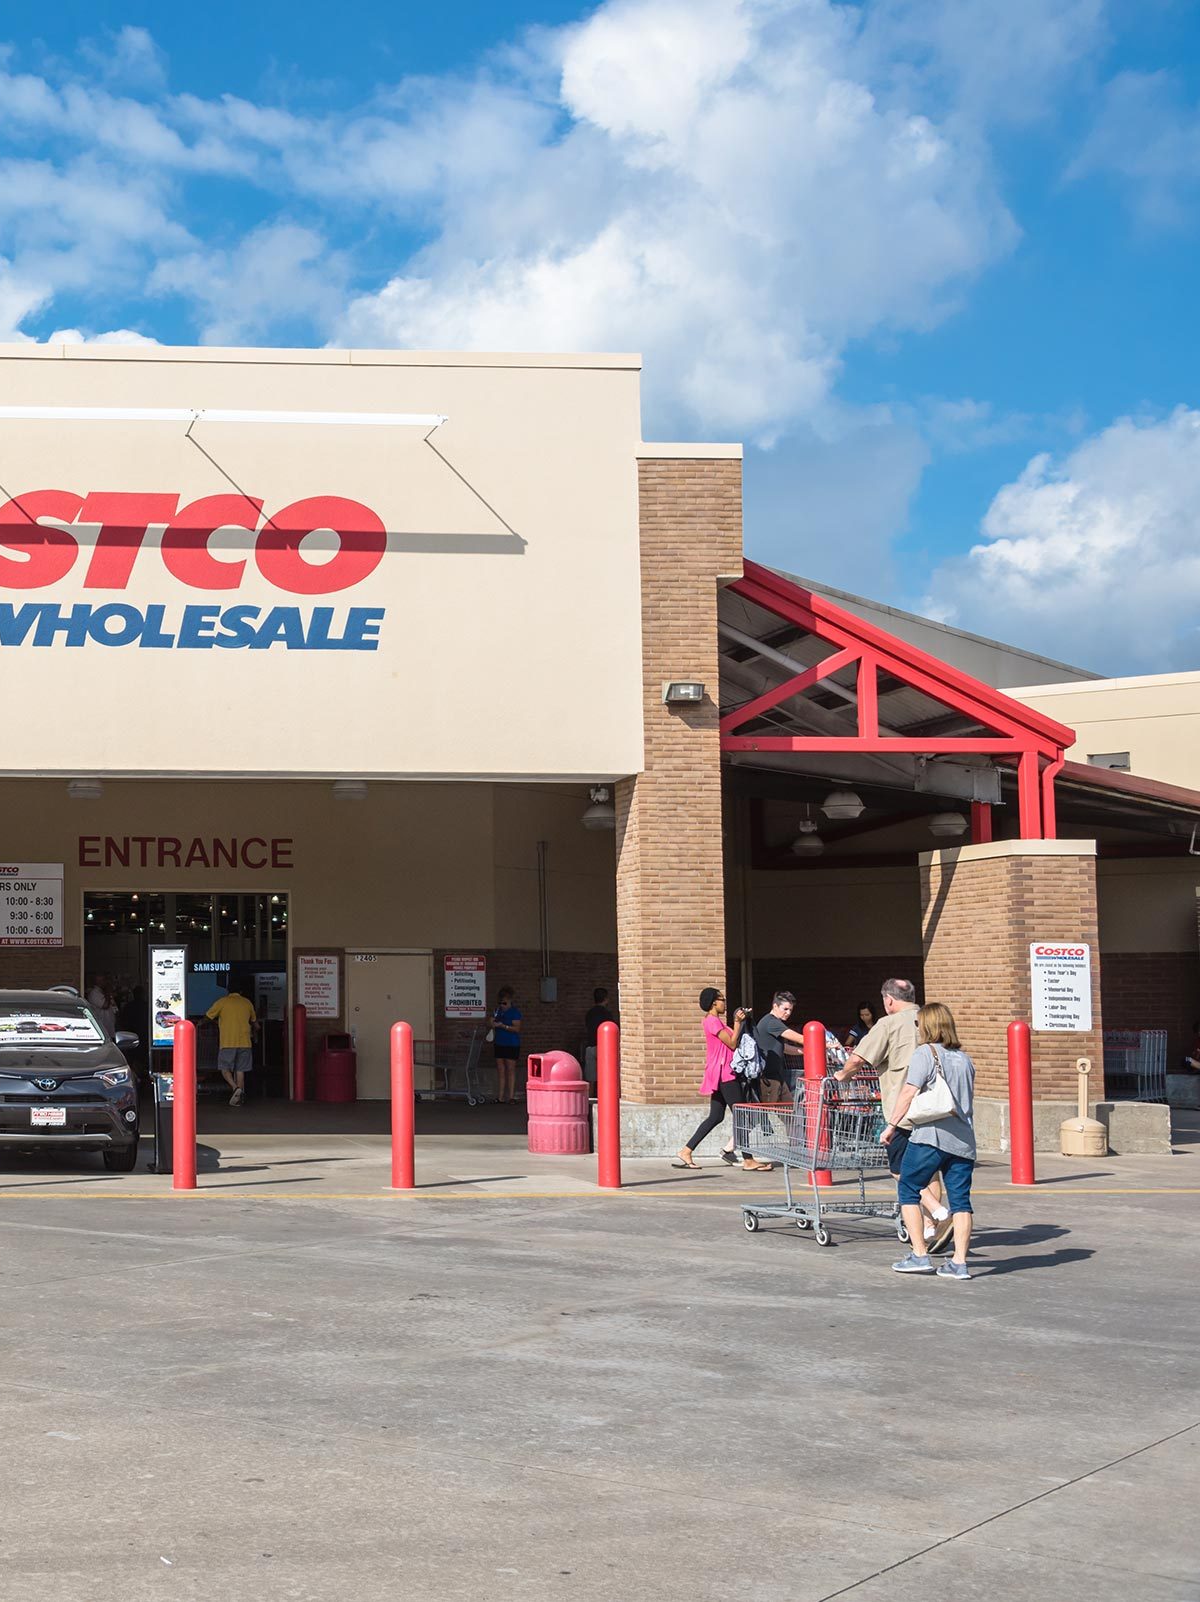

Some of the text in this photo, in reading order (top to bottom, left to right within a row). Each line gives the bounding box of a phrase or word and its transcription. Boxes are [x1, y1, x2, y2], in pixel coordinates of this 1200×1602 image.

[78, 836, 294, 869] ENTRANCE
[13, 882, 37, 891] ONLY
[5, 897, 28, 906] 10:00
[35, 897, 54, 906] 8:30
[9, 911, 28, 920] 9:30
[35, 911, 54, 920] 6:00
[5, 926, 28, 935] 10:00
[35, 926, 54, 935] 6:00
[1035, 946, 1085, 956] COSTCO
[194, 963, 231, 971] SAMSUNG
